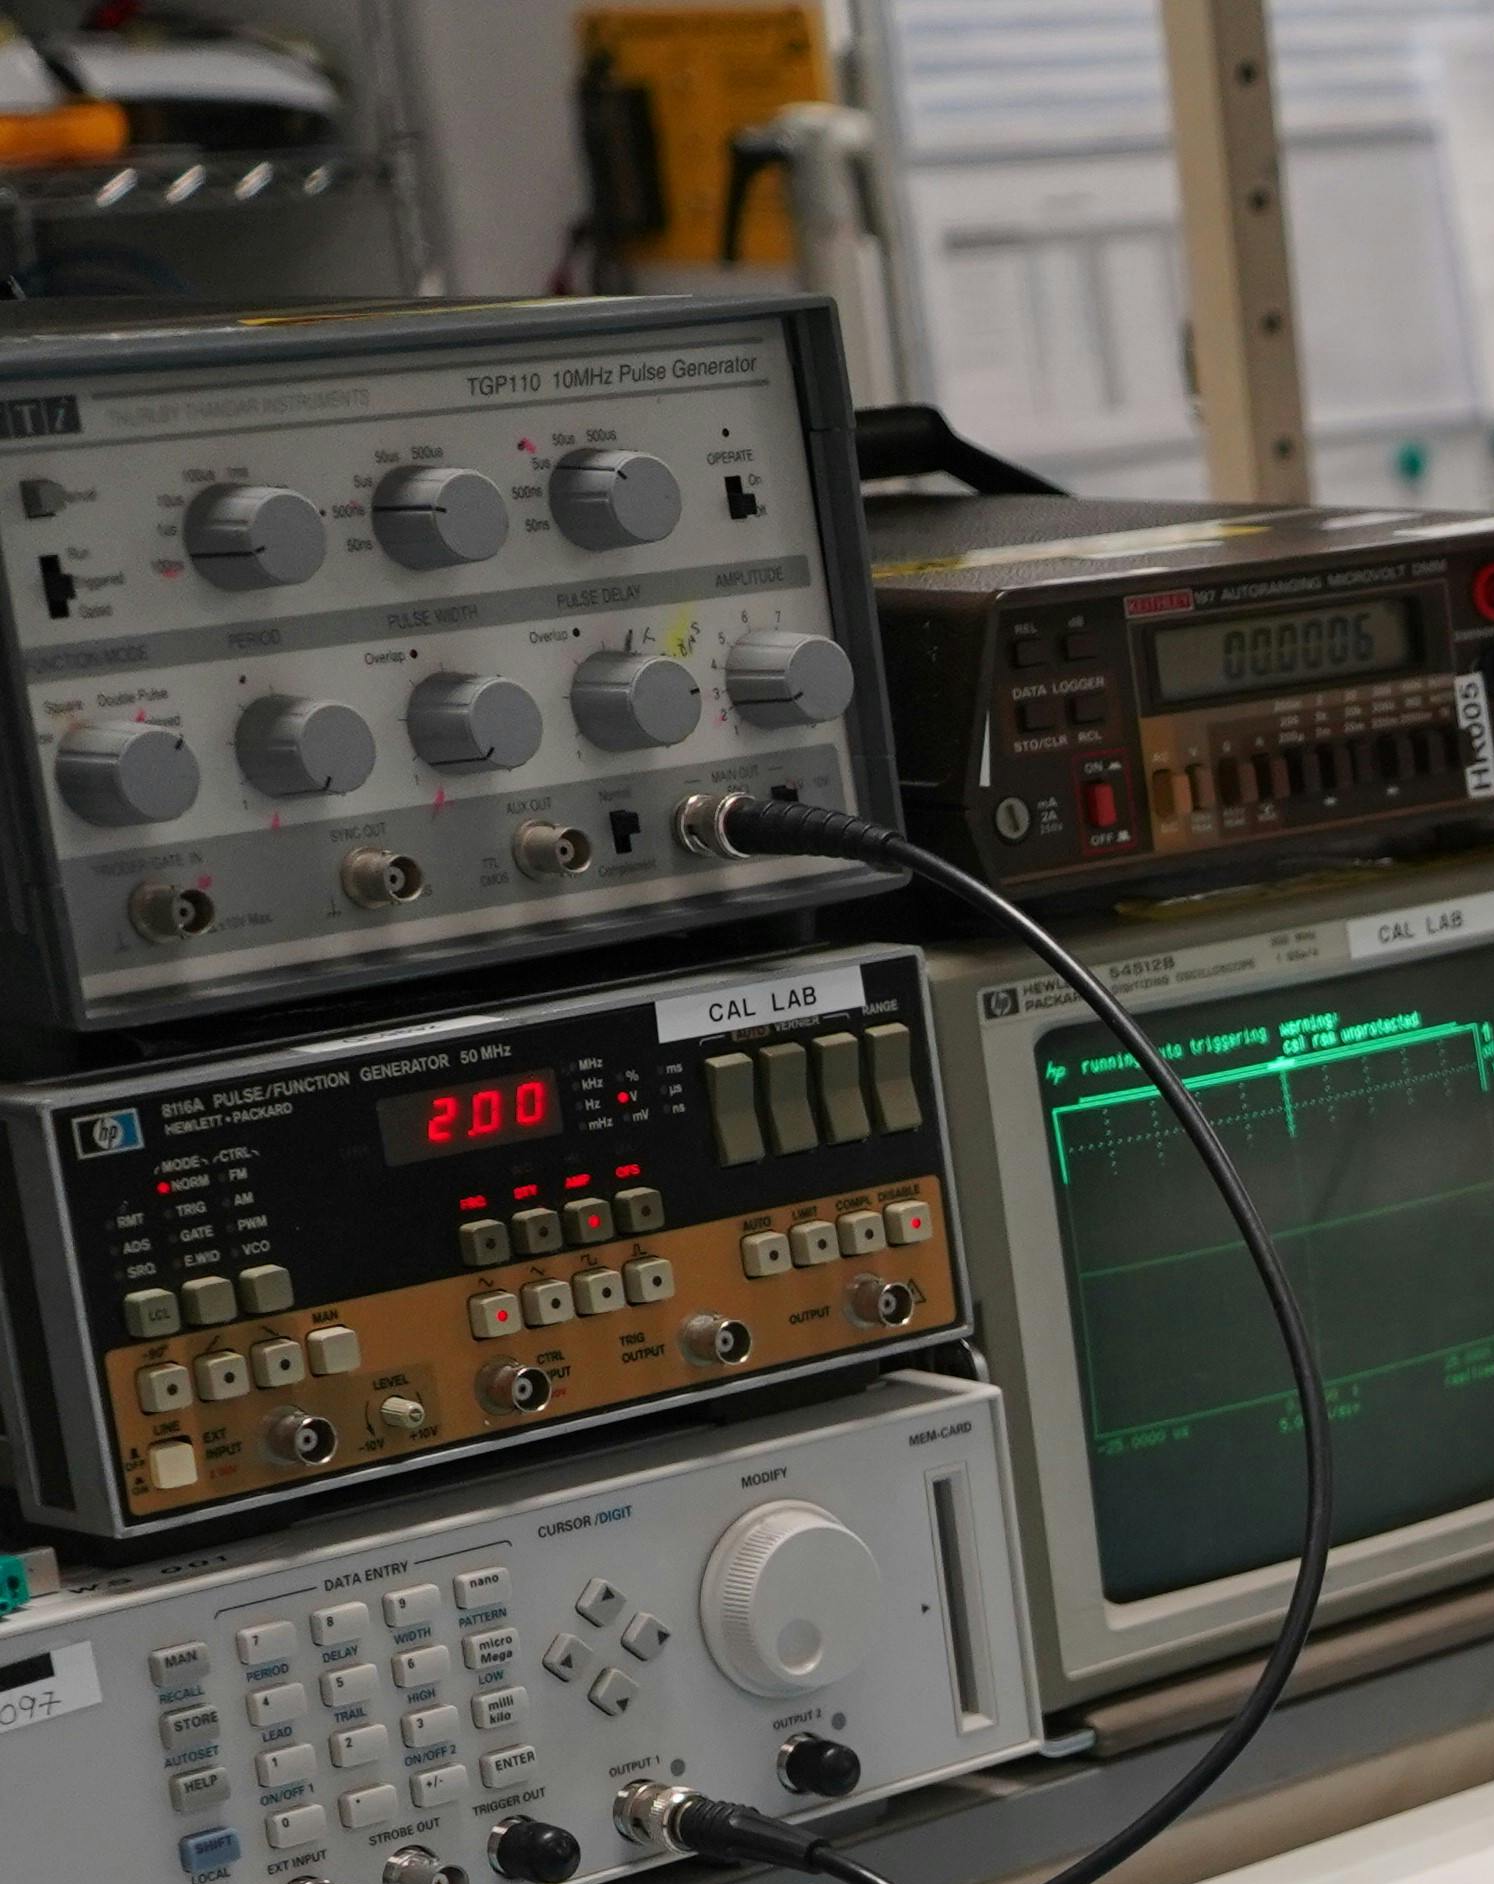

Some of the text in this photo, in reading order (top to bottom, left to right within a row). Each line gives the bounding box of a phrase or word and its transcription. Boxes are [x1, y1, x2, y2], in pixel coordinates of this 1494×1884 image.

[467, 356, 757, 397] TGP110 10MHz Pulse Generator
[706, 449, 754, 466] OPERATE
[714, 565, 785, 588] AMPLITUDE
[602, 584, 641, 604] DELAY
[1220, 575, 1323, 601] AUTORANGING
[387, 610, 431, 630] PULSE
[227, 629, 282, 650] PERIOD
[529, 628, 569, 645] Overlap
[364, 648, 405, 666] Overlap
[1012, 676, 1106, 700] DATA LOGGER
[1013, 730, 1103, 753] STO/CLR RCL
[1090, 831, 1113, 846] OFF
[1377, 910, 1464, 944] CAL LAB
[709, 984, 817, 1023] CAL LAB
[861, 998, 899, 1016] RANGE
[1189, 1025, 1269, 1057] triggering
[578, 1056, 604, 1071] MHz
[666, 1062, 683, 1075] ms
[160, 1043, 512, 1119] 8116A PULSE/FUNCTION GENERATOR 50 MHz
[581, 1076, 604, 1091] kHz
[625, 1069, 640, 1082] %
[585, 1097, 602, 1111] Hz
[588, 1115, 614, 1131] mHz
[632, 1108, 650, 1122] mV
[161, 1146, 250, 1175] MODE CTRL
[171, 1167, 248, 1193] NORM FM
[116, 1191, 255, 1231] RMT TRIG AM
[742, 1183, 921, 1232] AUTO LIMIT DISABLE
[122, 1213, 268, 1256] ADS GATE PWM
[127, 1261, 157, 1279] SRQ
[242, 1239, 271, 1257] VCO
[311, 1308, 339, 1324] MAN
[788, 1305, 831, 1325] OUTPUT
[618, 1331, 646, 1347] TRIG
[536, 1349, 565, 1366] CTRL
[621, 1343, 666, 1364] OUTPUT
[372, 1373, 409, 1392] LEVEL
[152, 1419, 181, 1436] LINE
[203, 1427, 227, 1445] EXT
[908, 1420, 973, 1448] MEM-CARD
[358, 1424, 440, 1454] -10V +10V
[205, 1440, 243, 1460] INPUT
[740, 1466, 788, 1490] MODIFY
[537, 1505, 634, 1539] CURSOR /DIGIT
[323, 1563, 408, 1593] DATA ENTRY
[469, 1574, 500, 1590] nano
[458, 1606, 508, 1630] PATTERN
[393, 1625, 432, 1646] WIDTH
[479, 1634, 513, 1651] micro
[165, 1650, 198, 1670] MAN
[322, 1645, 359, 1665] DELAY
[480, 1648, 513, 1666] Mega
[246, 1663, 290, 1683] PERIOD
[478, 1669, 504, 1686] LOW
[159, 1685, 205, 1704] RECALL
[407, 1687, 436, 1703] HIGH
[487, 1695, 514, 1712] milli
[173, 1711, 220, 1734] STORE
[334, 1705, 367, 1724] TRAIL
[489, 1708, 513, 1724] kilo
[772, 1714, 812, 1731] OUTPUT
[261, 1725, 293, 1744] LEAD
[164, 1744, 220, 1769] AUTOSET
[404, 1746, 449, 1767] ON/OFF
[494, 1750, 536, 1772] ENTER
[608, 1759, 652, 1779] OUTPUT
[184, 1773, 219, 1794] HELP
[260, 1786, 306, 1807] ON/OFF
[472, 1786, 546, 1818] TRIGGER OUT
[368, 1817, 441, 1847] STROBE OUT
[195, 1834, 234, 1855] SHIFT
[267, 1849, 328, 1876] EXT INPUT
